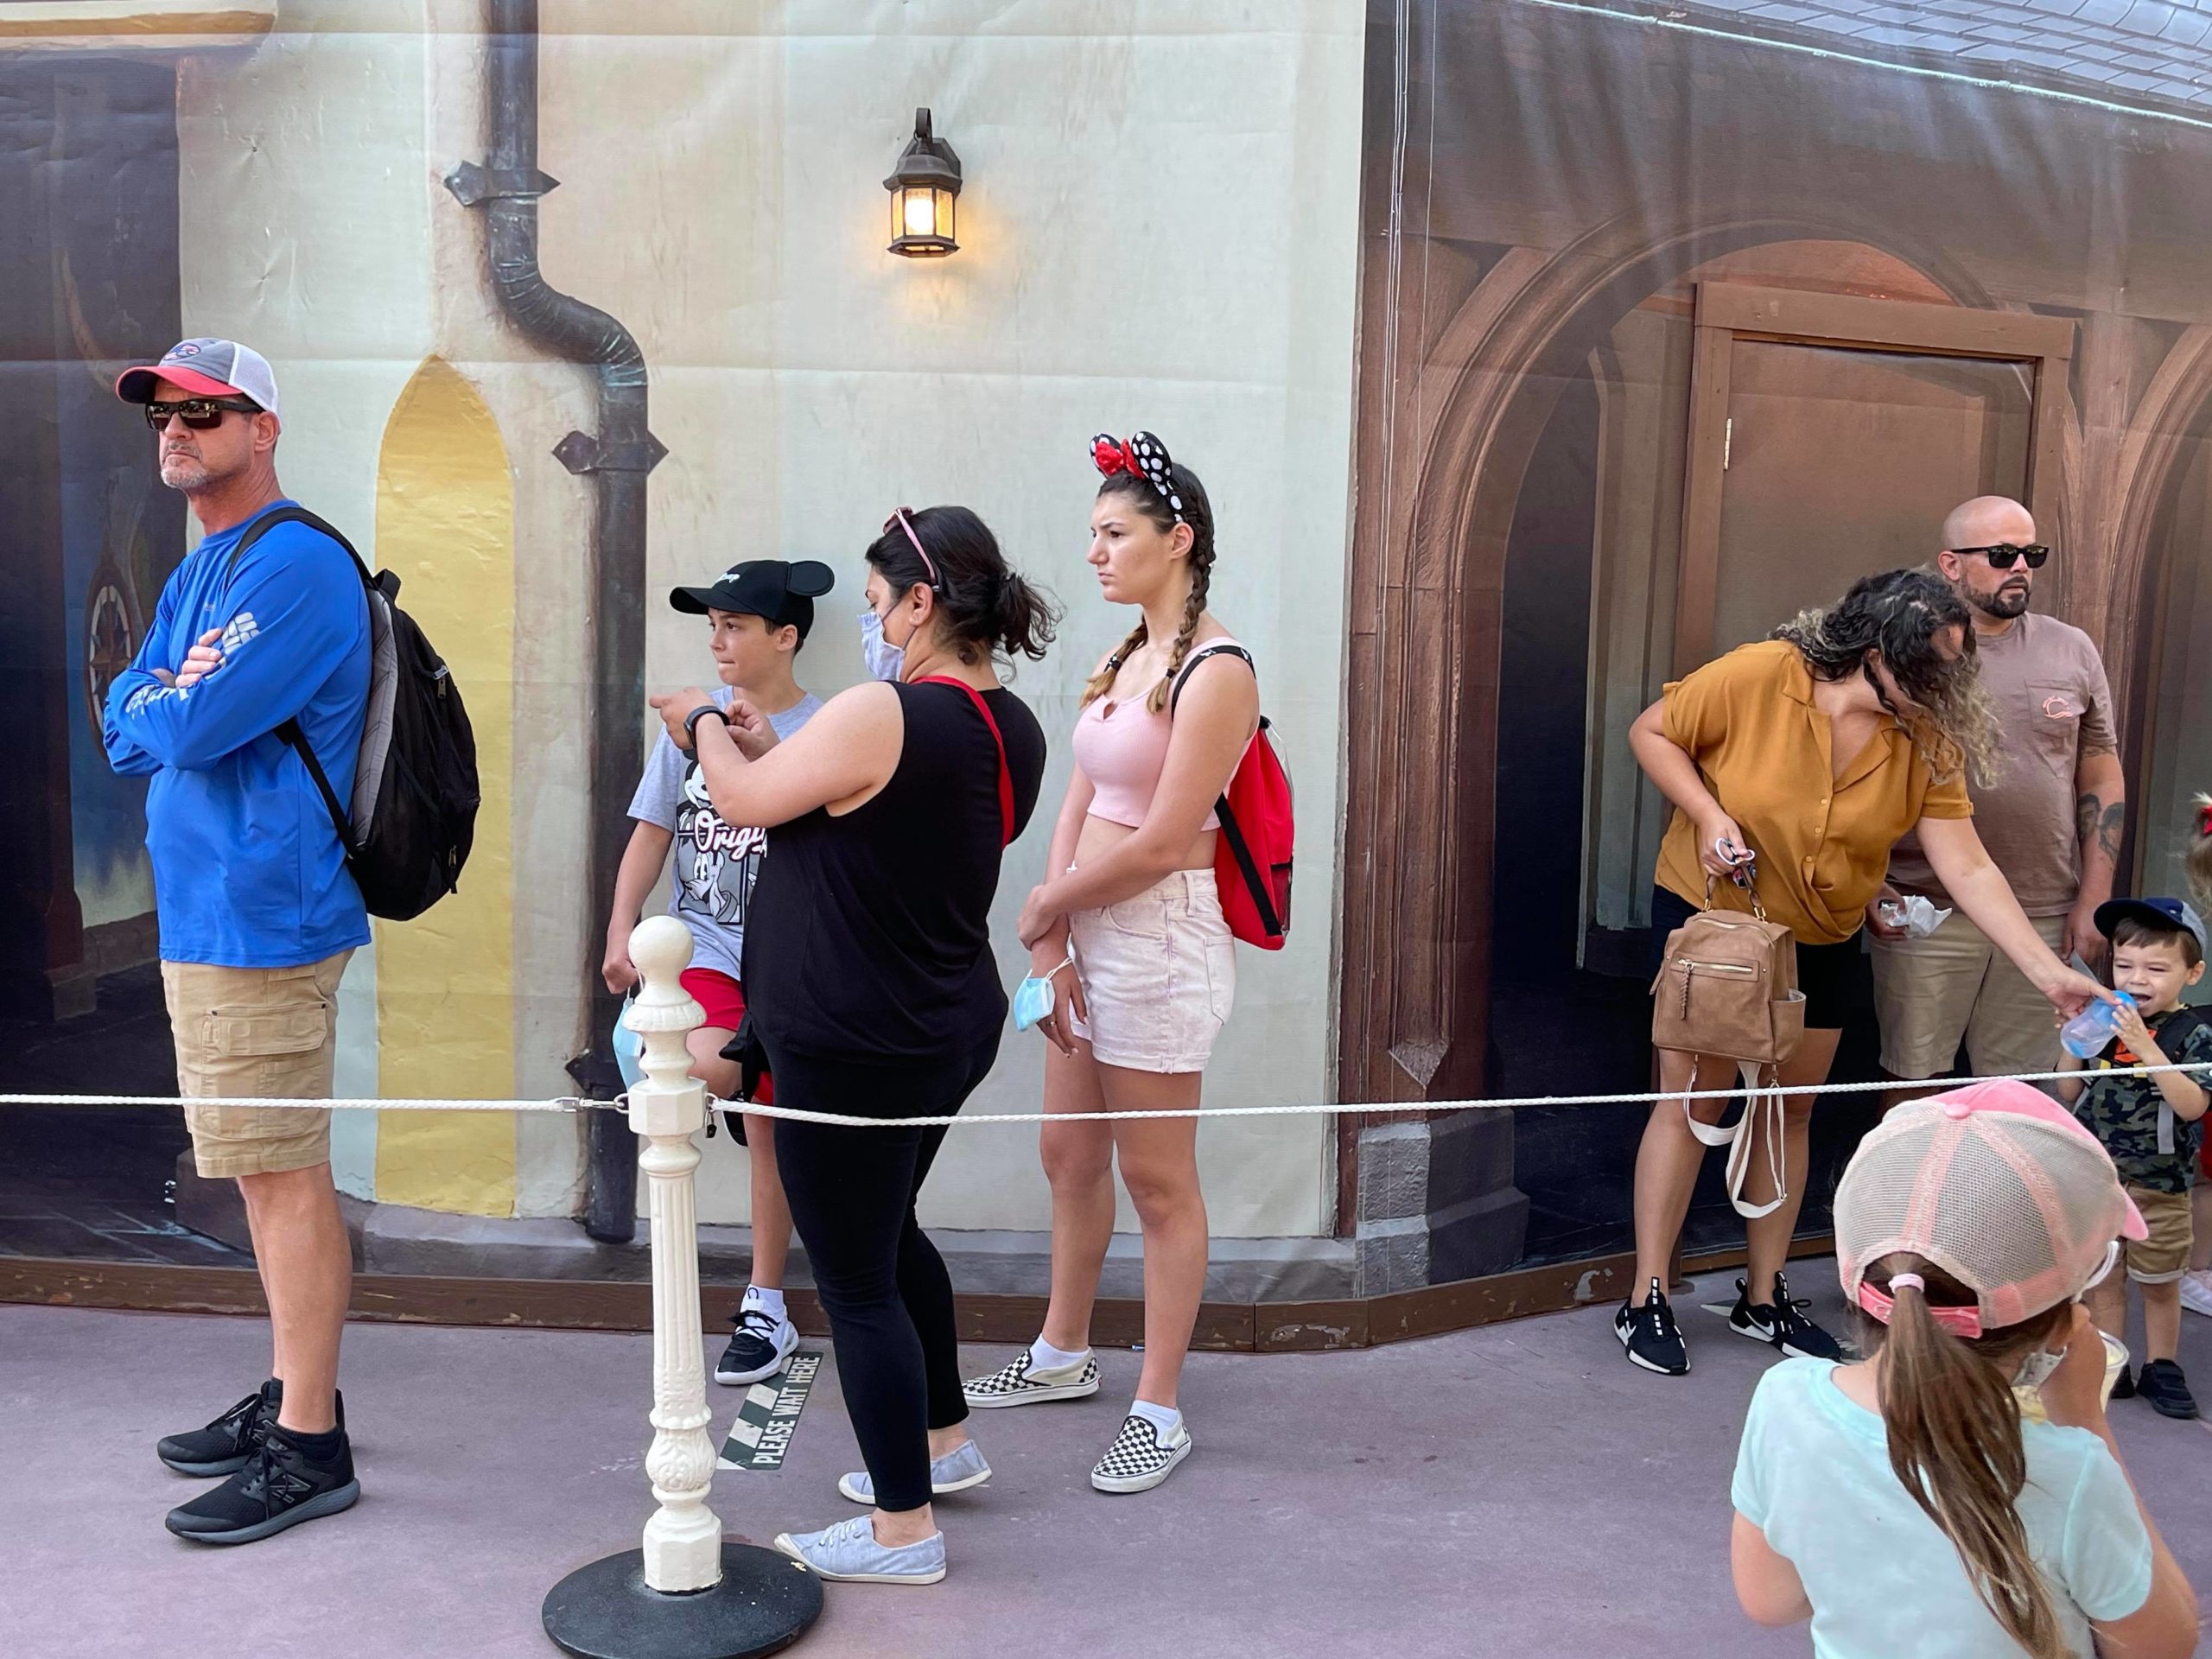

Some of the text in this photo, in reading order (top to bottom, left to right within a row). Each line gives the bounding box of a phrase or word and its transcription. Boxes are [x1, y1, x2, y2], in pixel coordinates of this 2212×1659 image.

[752, 1357, 820, 1464] PLEASE WAIT HERE
